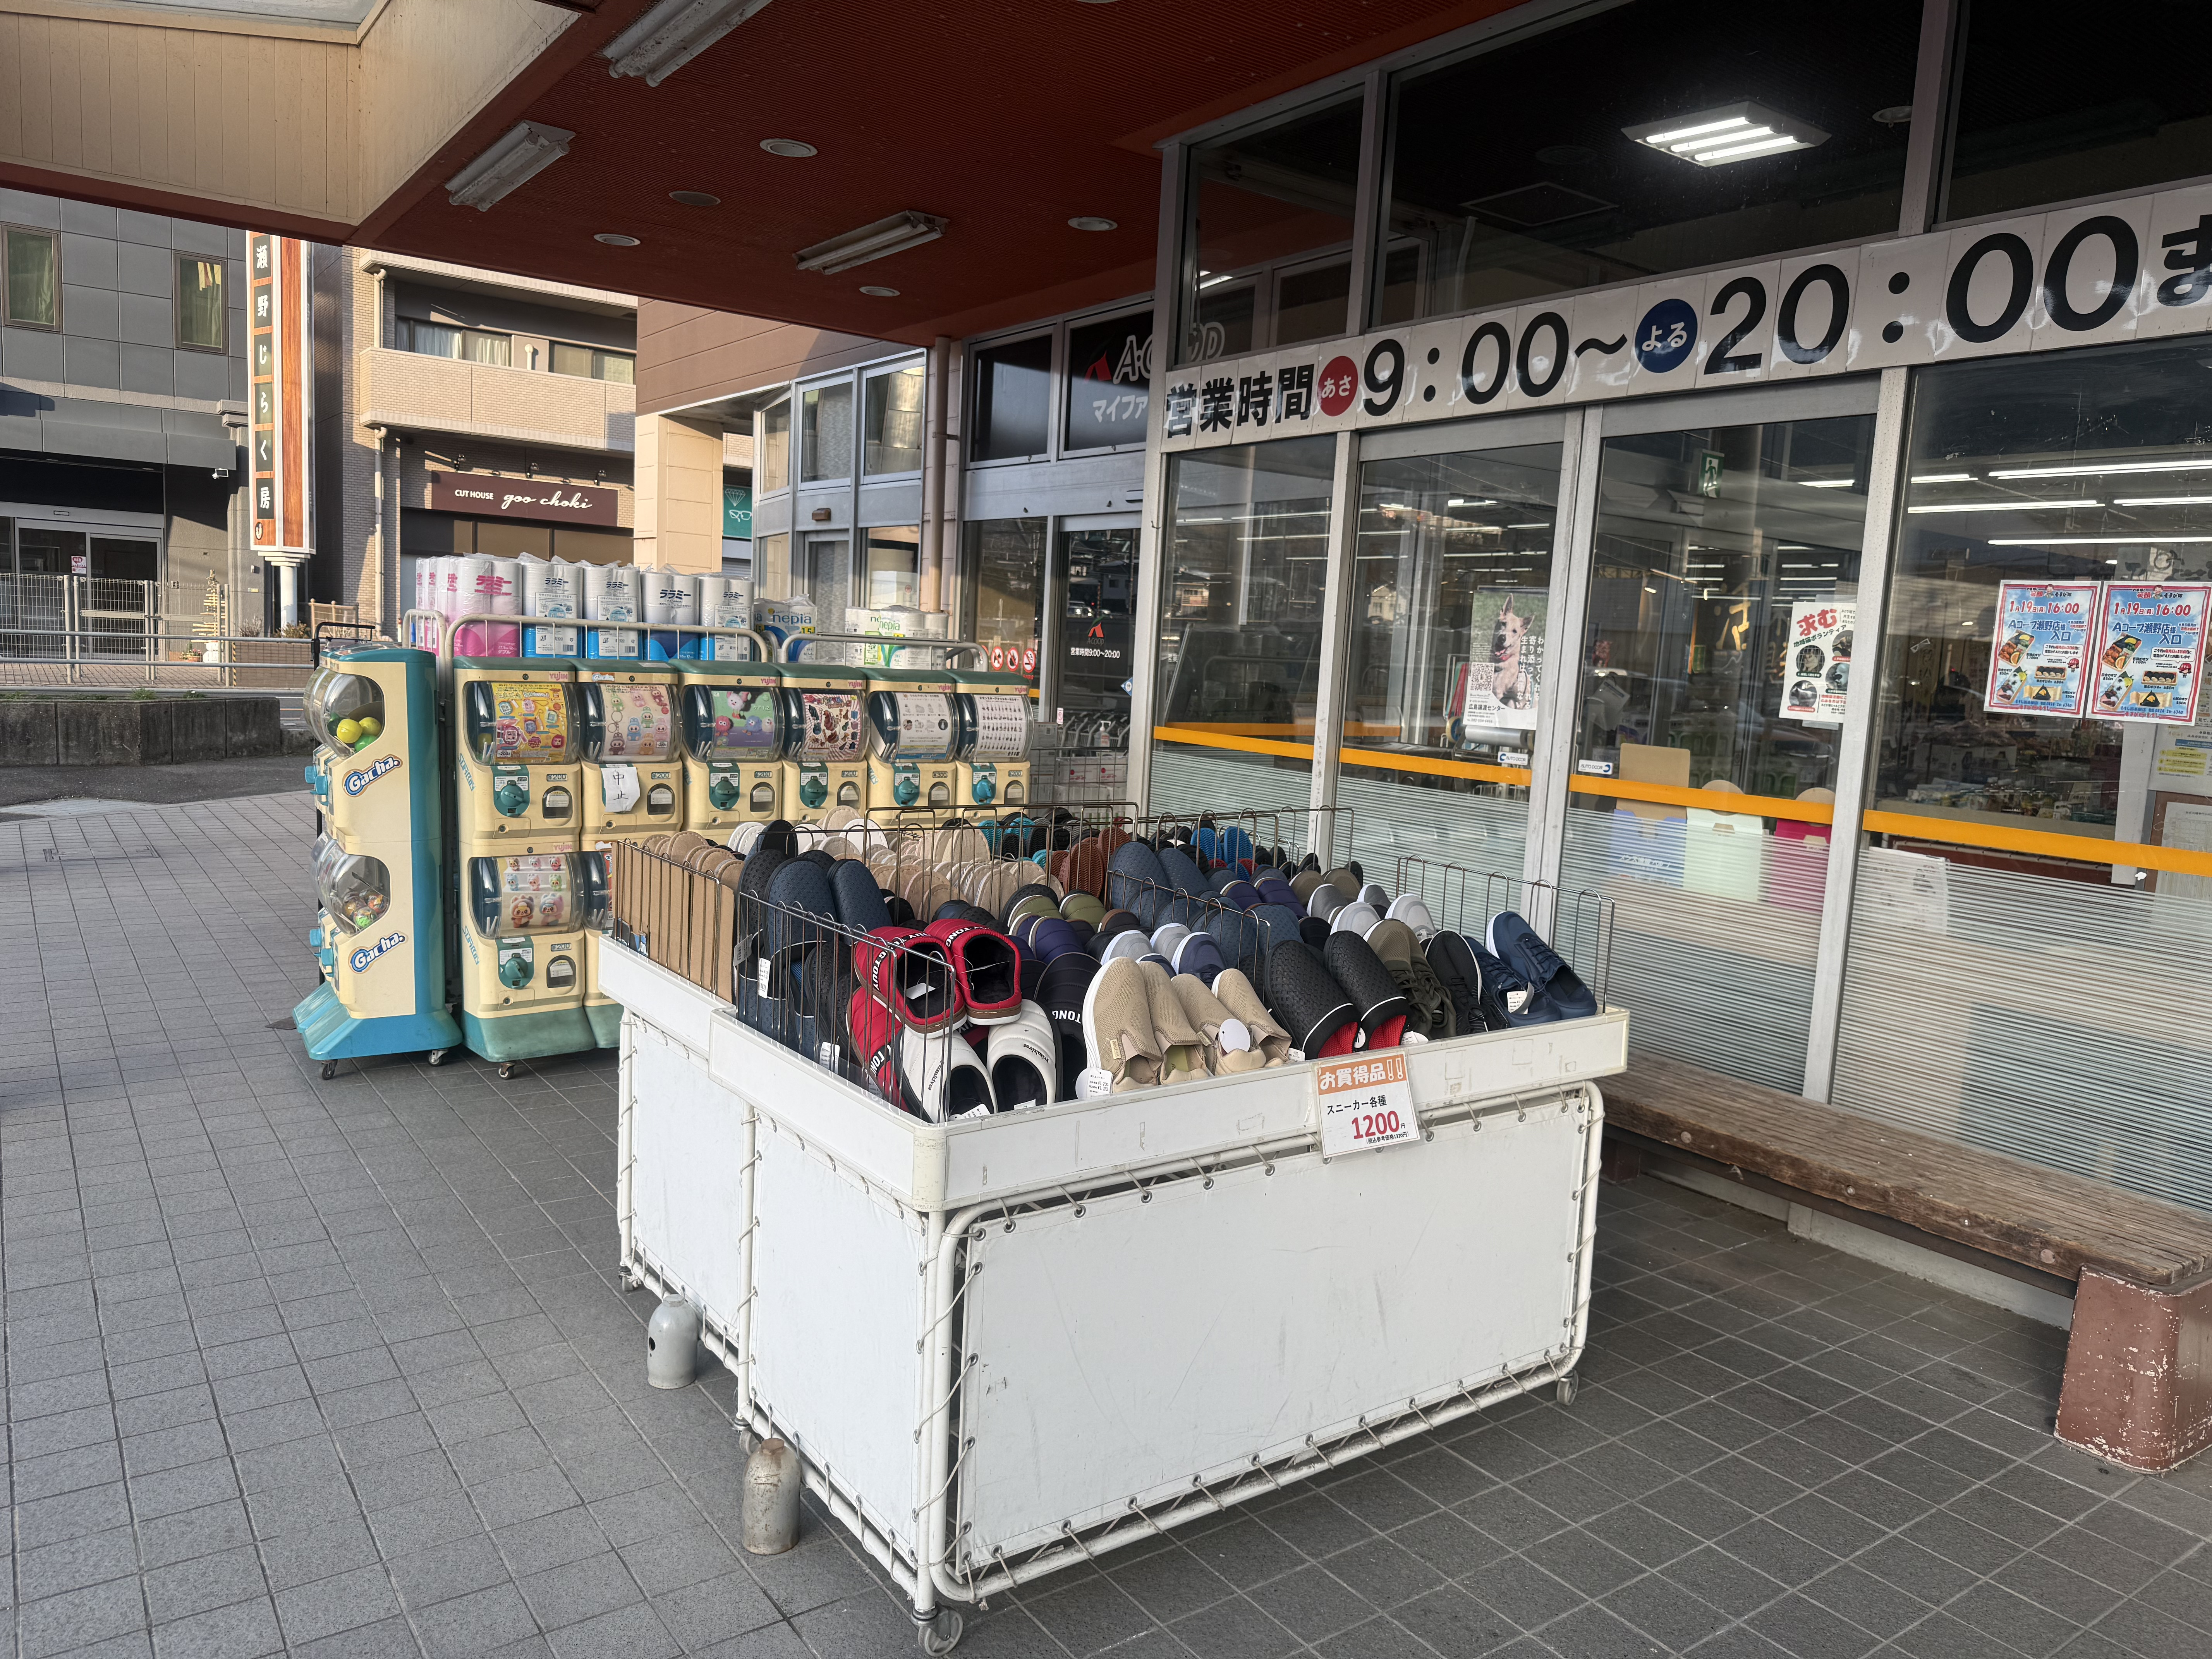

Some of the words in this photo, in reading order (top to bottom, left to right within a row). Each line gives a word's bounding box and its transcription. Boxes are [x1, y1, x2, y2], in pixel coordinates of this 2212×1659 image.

[256, 246, 271, 509] 瀬野じらく房
[1166, 363, 1315, 439] 営業時間
[1321, 374, 1352, 399] あさ
[1641, 321, 1690, 353] よる
[455, 489, 469, 498] CUT
[470, 491, 494, 500] HOUSE
[501, 493, 537, 510] goo
[540, 490, 593, 509] choki
[476, 575, 512, 587] ララミー
[660, 589, 691, 600] ララミー
[2048, 603, 2080, 614] 16:00
[2156, 604, 2191, 616] 16:00
[773, 614, 812, 625] nepia
[1796, 608, 1837, 637] 求む
[2008, 620, 2066, 631] Aコープ瀬野店様
[879, 621, 900, 631] nepia
[2112, 622, 2177, 634] Aコープ瀬野店様
[2050, 631, 2071, 642] 入口
[2159, 634, 2182, 644] 入口
[613, 771, 629, 800] 中止
[1051, 1010, 1082, 1024] TONG
[1327, 1095, 1387, 1115] スニーカー各種
